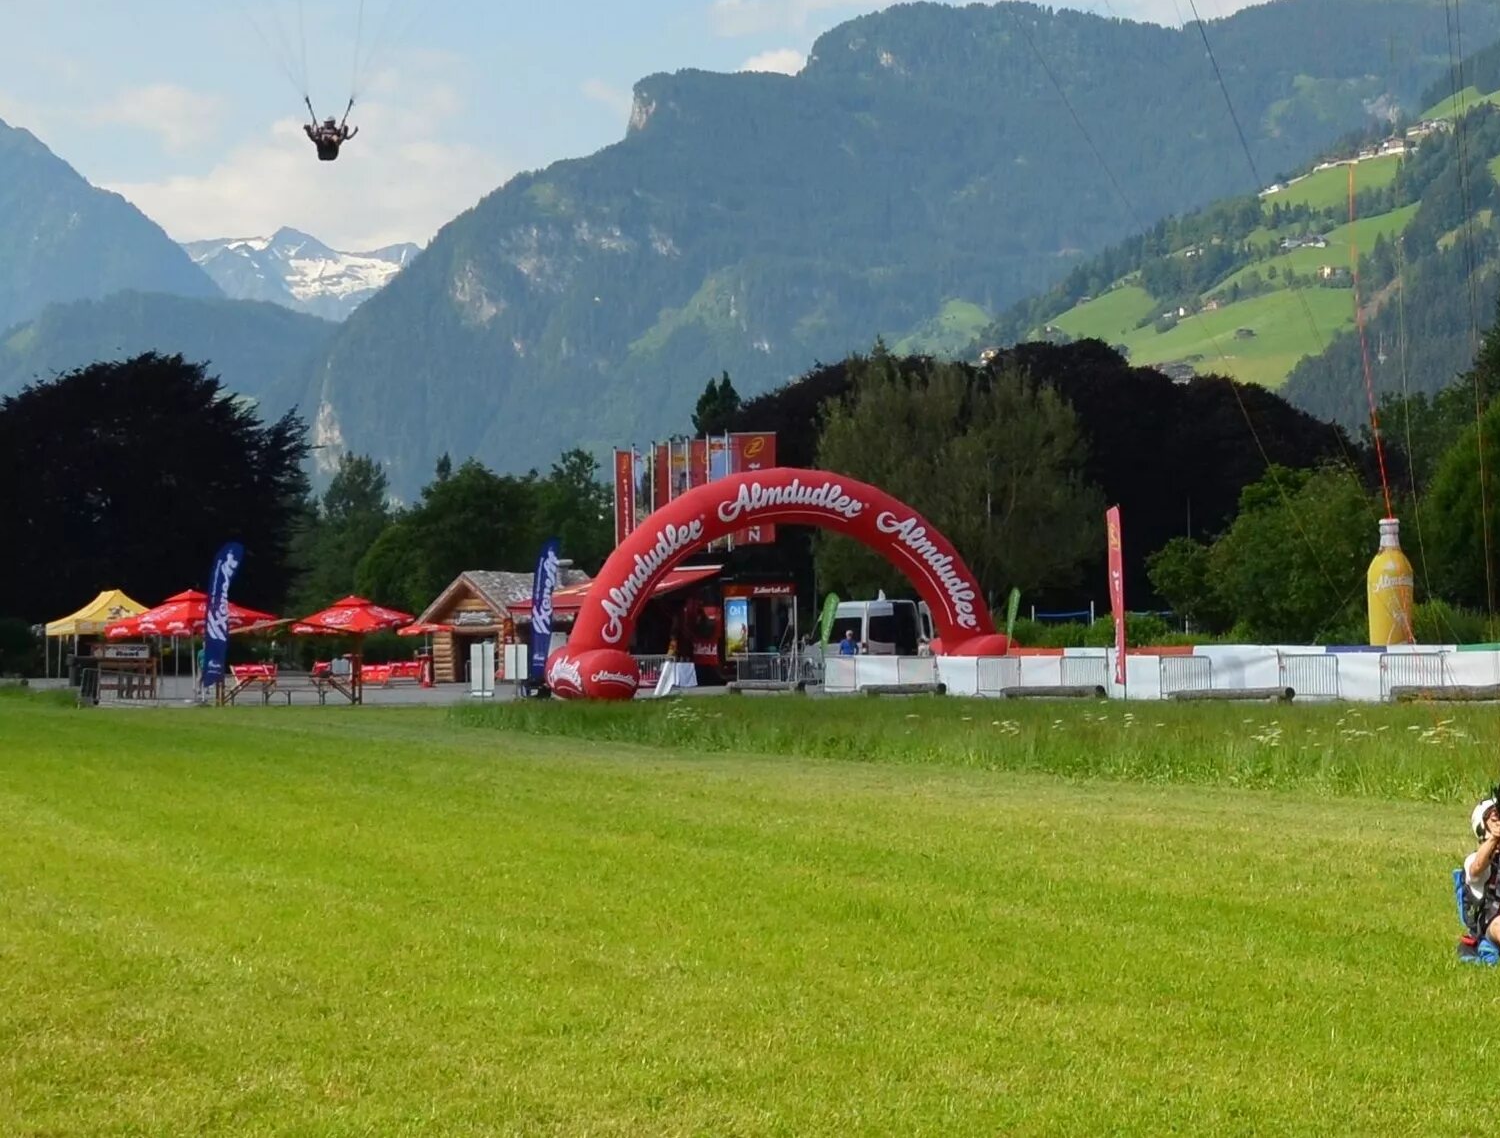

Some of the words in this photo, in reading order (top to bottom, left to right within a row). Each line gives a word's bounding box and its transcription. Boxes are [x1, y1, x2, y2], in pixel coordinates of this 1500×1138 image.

[718, 478, 863, 522] Almdudler
[600, 519, 704, 643] Almdudler
[876, 511, 977, 629] Almdudler
